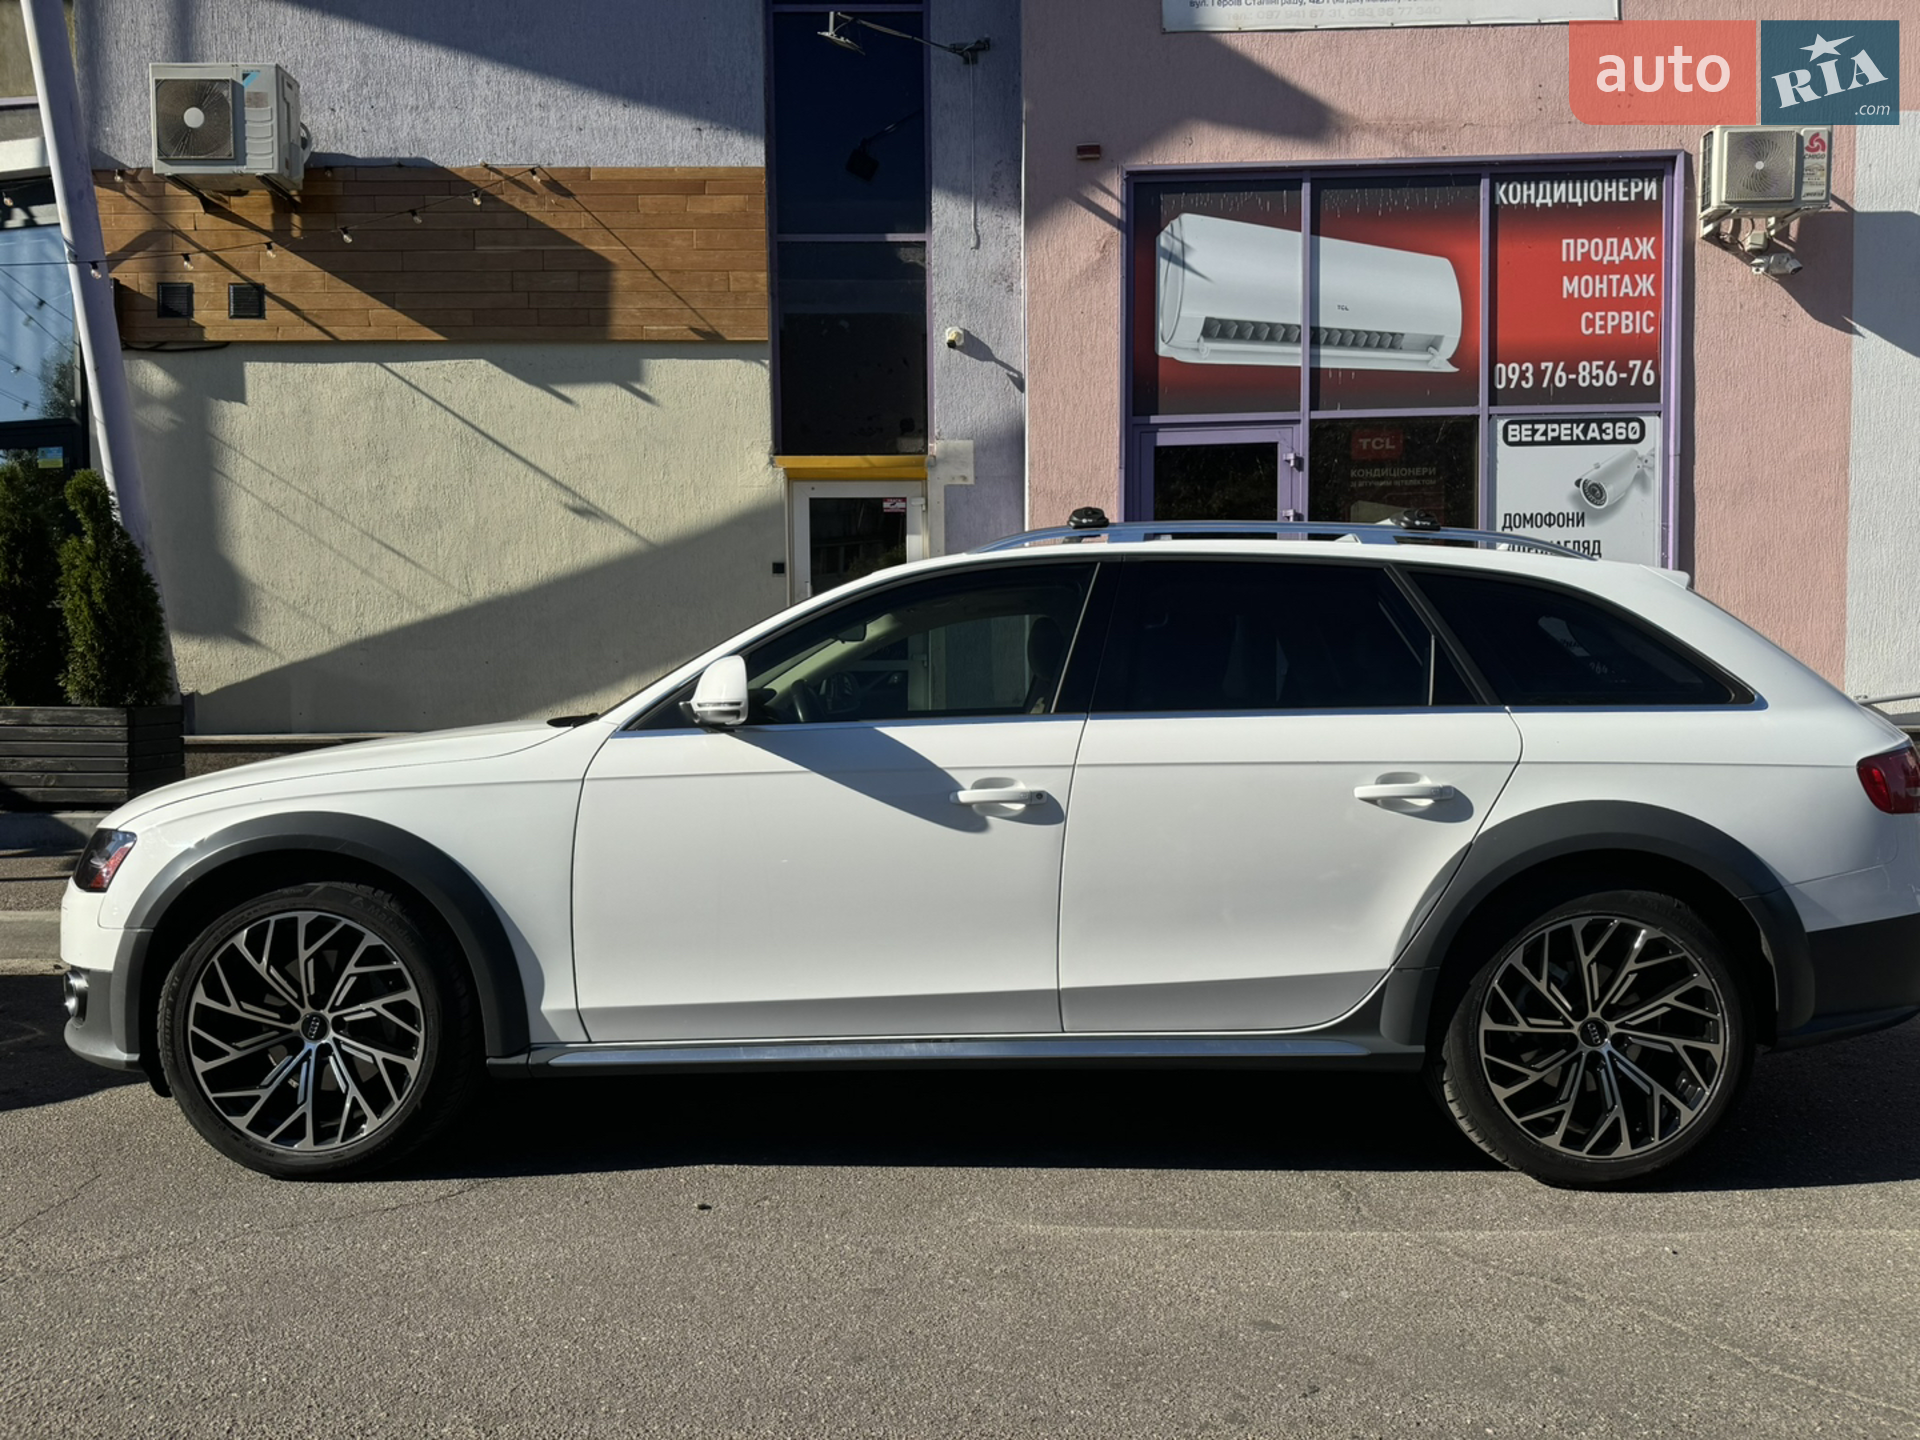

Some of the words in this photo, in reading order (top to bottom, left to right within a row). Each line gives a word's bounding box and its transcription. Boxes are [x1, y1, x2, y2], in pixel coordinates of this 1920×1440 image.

[1494, 178, 1658, 207] КОНДИЦІОНЕРИ
[1561, 237, 1656, 264] ПРОДАЖ
[1562, 274, 1656, 299] МОНТАЖ
[1580, 310, 1655, 335] СЕРВІС
[1494, 361, 1534, 389] 093
[1540, 360, 1656, 389] 76-856-76
[1358, 437, 1396, 451] TCL
[1507, 422, 1641, 442] BEZPEKA360
[1350, 467, 1437, 478] КОНДИЦІОНЕРИ
[1501, 512, 1585, 531] ДОМОФОНИ
